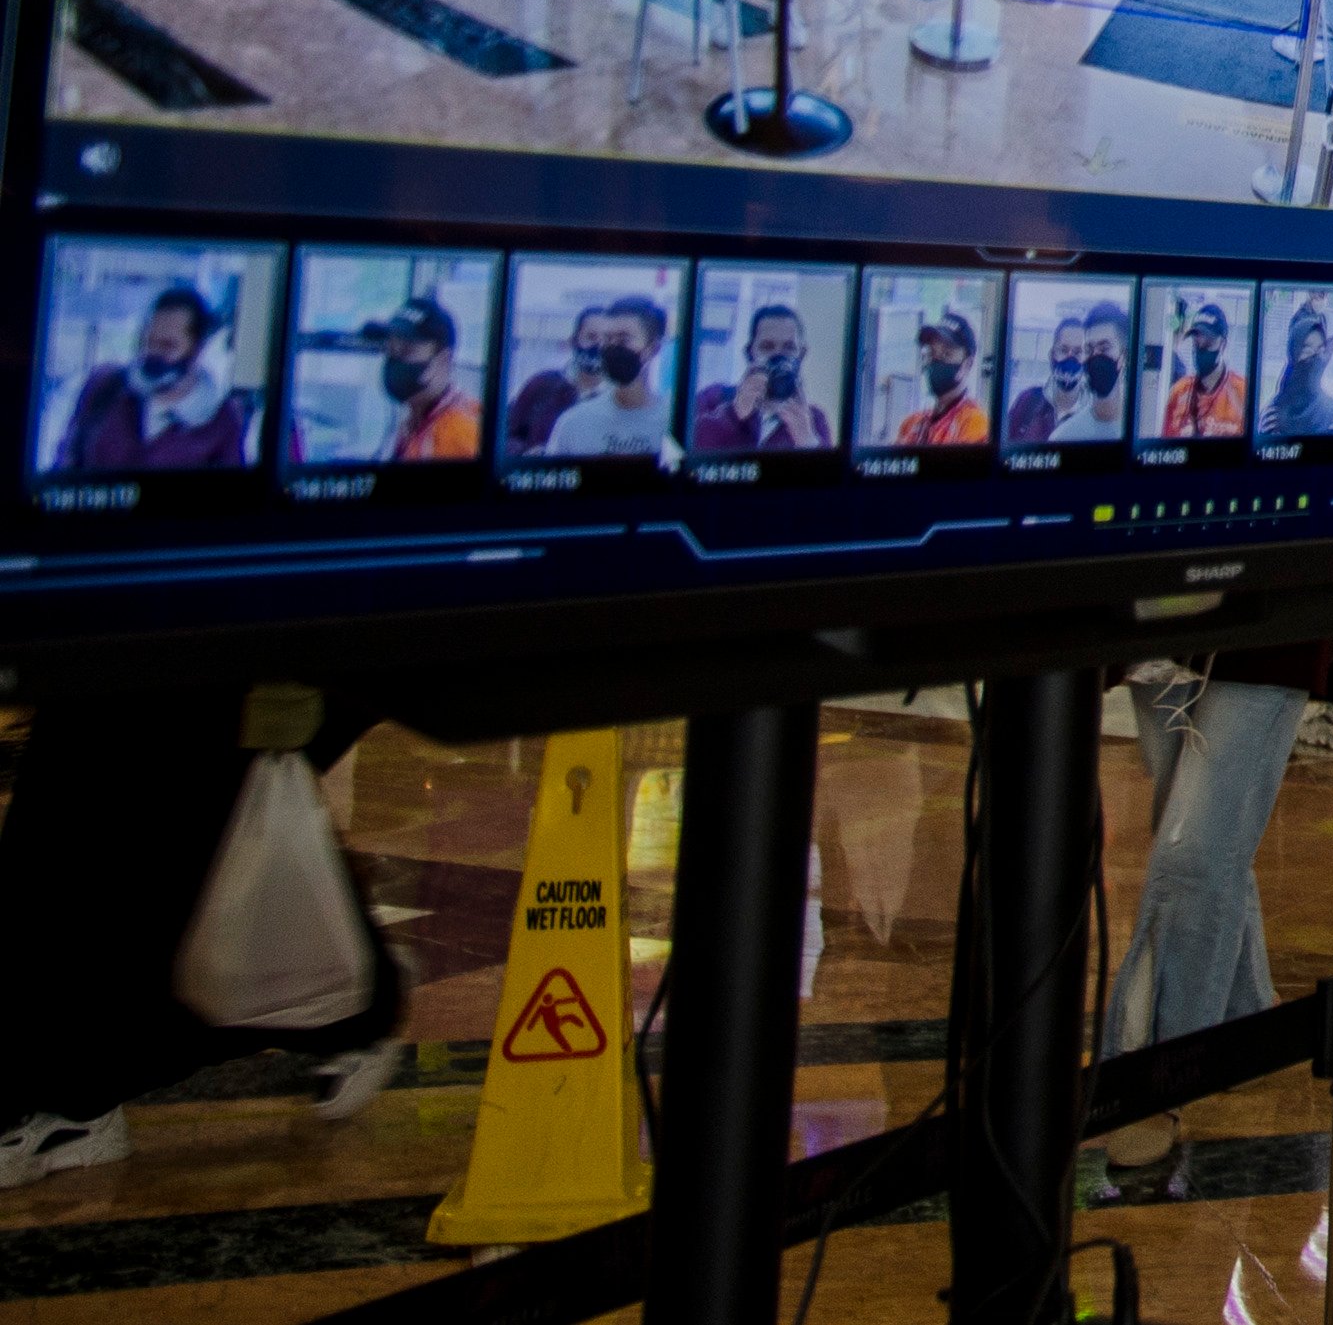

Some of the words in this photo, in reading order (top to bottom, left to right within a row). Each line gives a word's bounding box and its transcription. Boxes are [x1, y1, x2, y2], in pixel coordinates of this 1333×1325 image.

[1260, 444, 1301, 460] 14:13:47
[537, 880, 602, 903] CAUTION
[526, 907, 558, 931] WET
[559, 906, 606, 930] FLOOR
